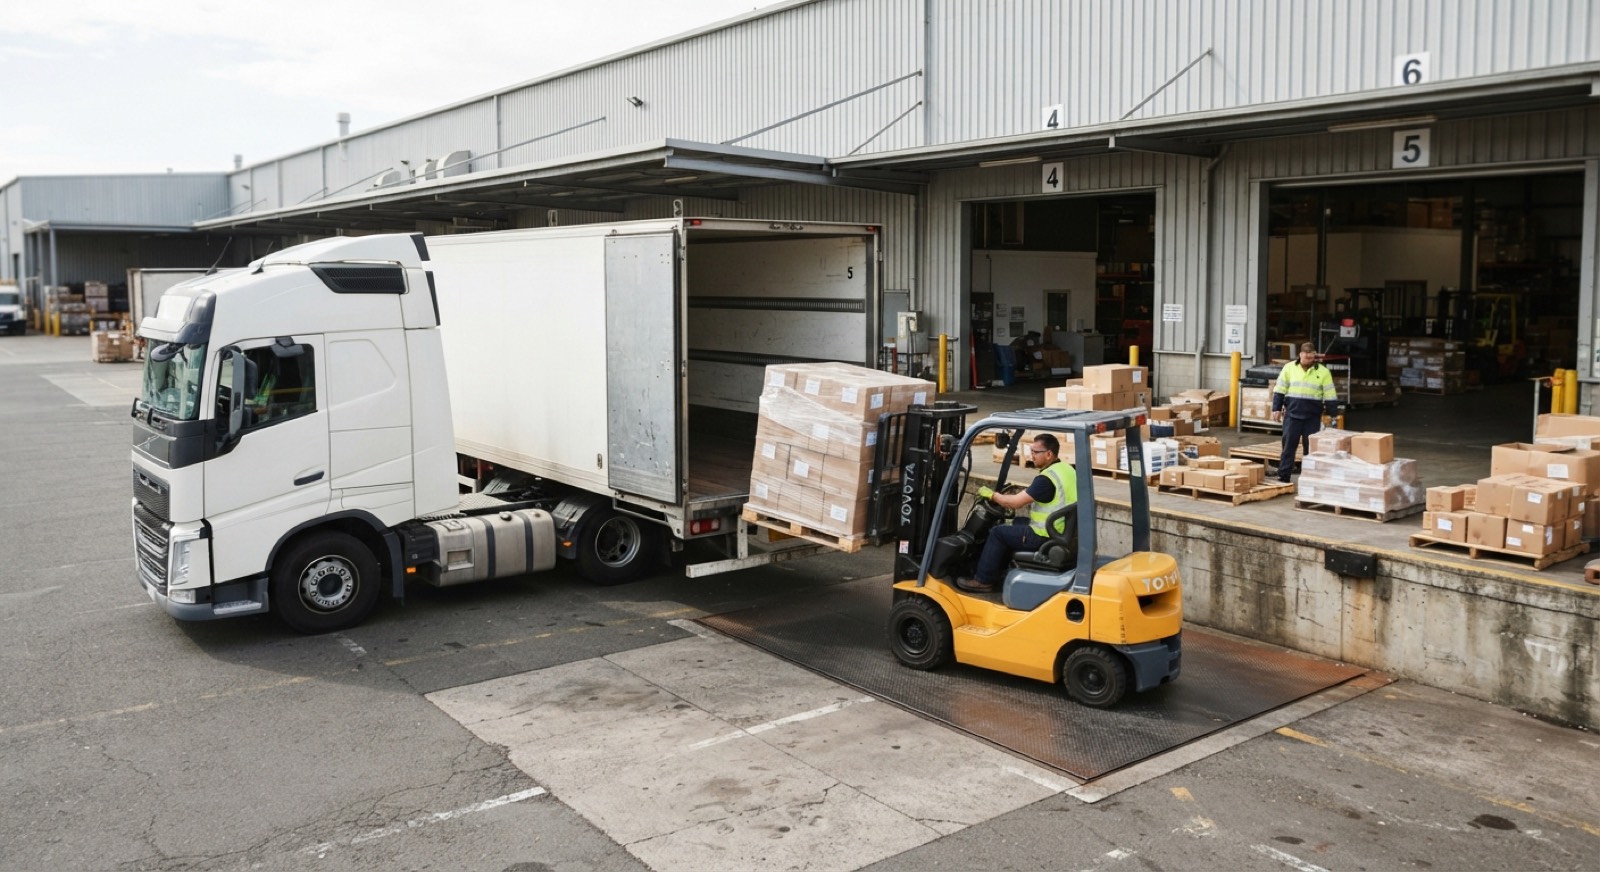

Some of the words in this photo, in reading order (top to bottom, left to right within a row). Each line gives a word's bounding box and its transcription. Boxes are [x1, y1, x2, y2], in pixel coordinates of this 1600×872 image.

[1402, 58, 1422, 85] 6
[1047, 109, 1059, 129] 4
[1402, 134, 1421, 163] 5
[1046, 166, 1059, 188] 4
[847, 266, 853, 280] 5
